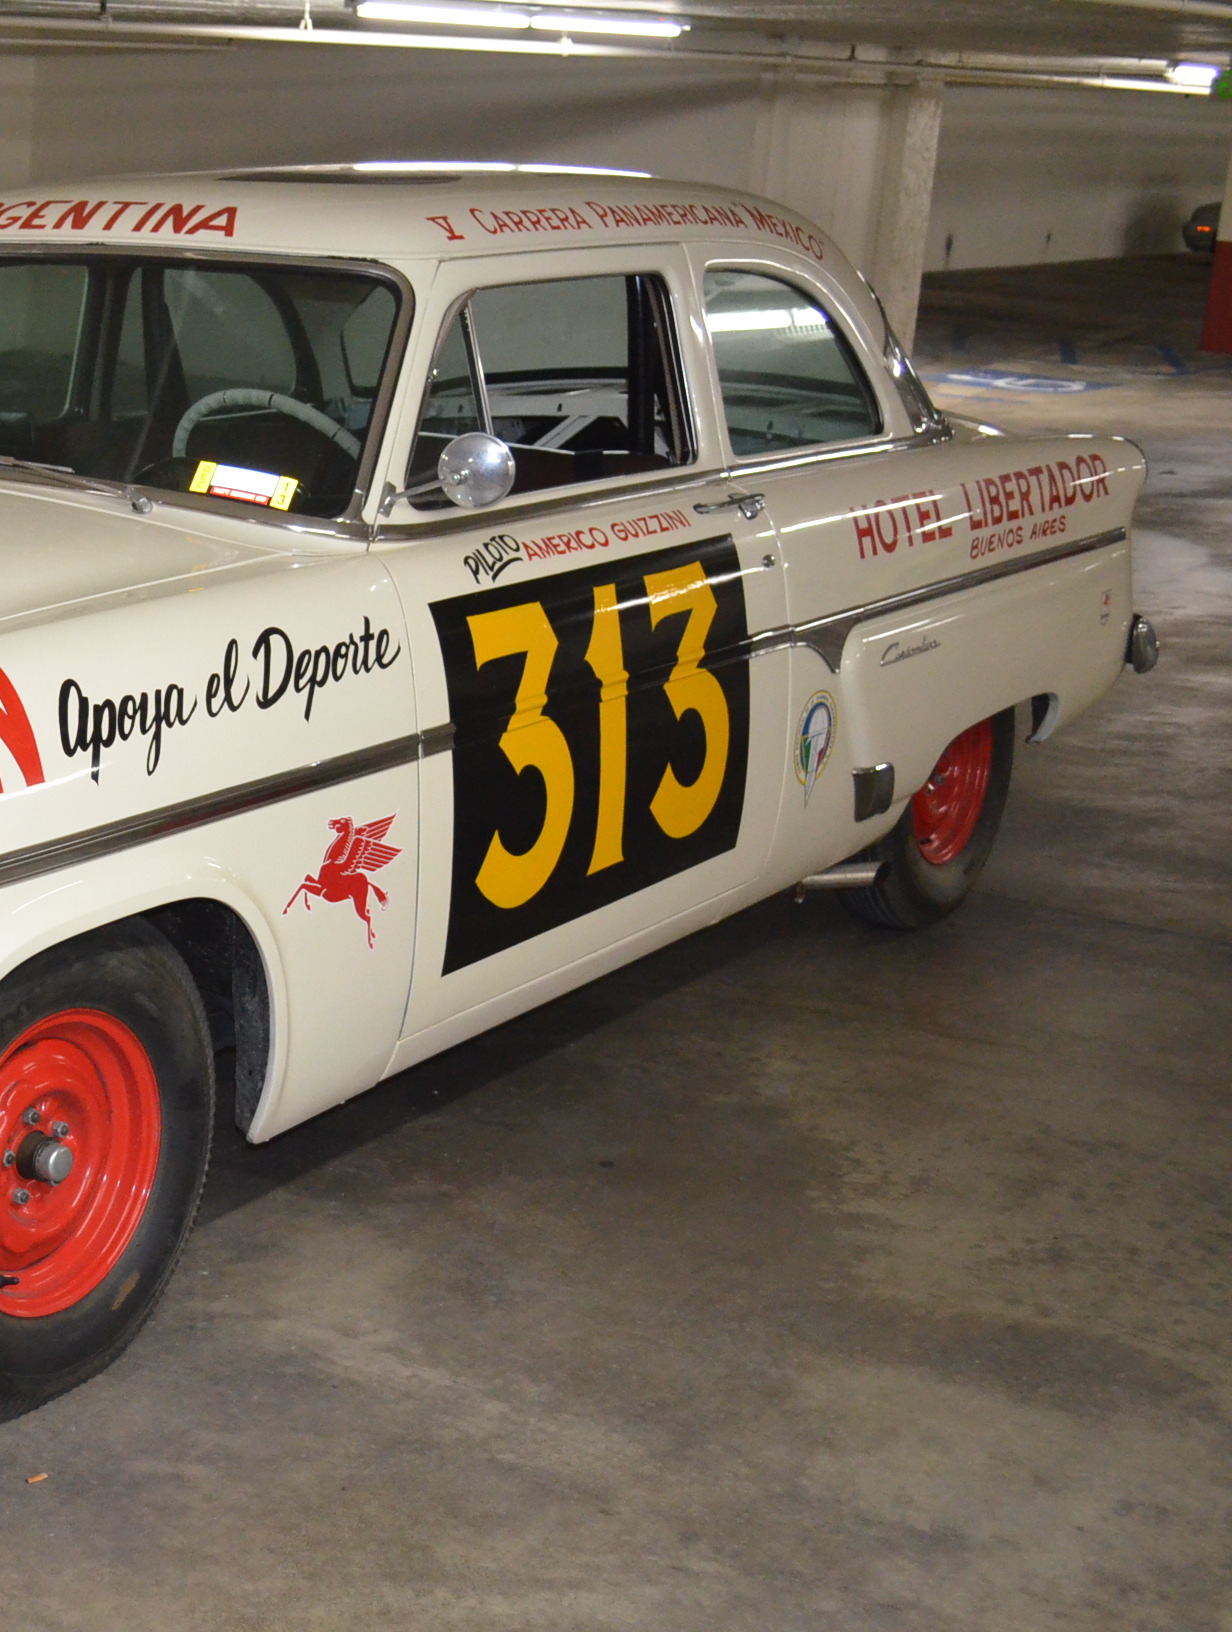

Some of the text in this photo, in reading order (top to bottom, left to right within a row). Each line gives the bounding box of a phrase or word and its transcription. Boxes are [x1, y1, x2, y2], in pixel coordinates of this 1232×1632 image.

[425, 216, 465, 240] V
[469, 207, 593, 234] CARRERA
[585, 201, 748, 228] PANAMERICANA
[277, 482, 291, 505] 13
[850, 453, 1109, 559] HOTEL LIBERTADOR
[463, 509, 692, 584] PILOTO AMERICO GUIZZINI
[970, 515, 1066, 560] BUENOS AIRES
[58, 615, 401, 787] Apoya el Deporte
[465, 560, 730, 909] 313
